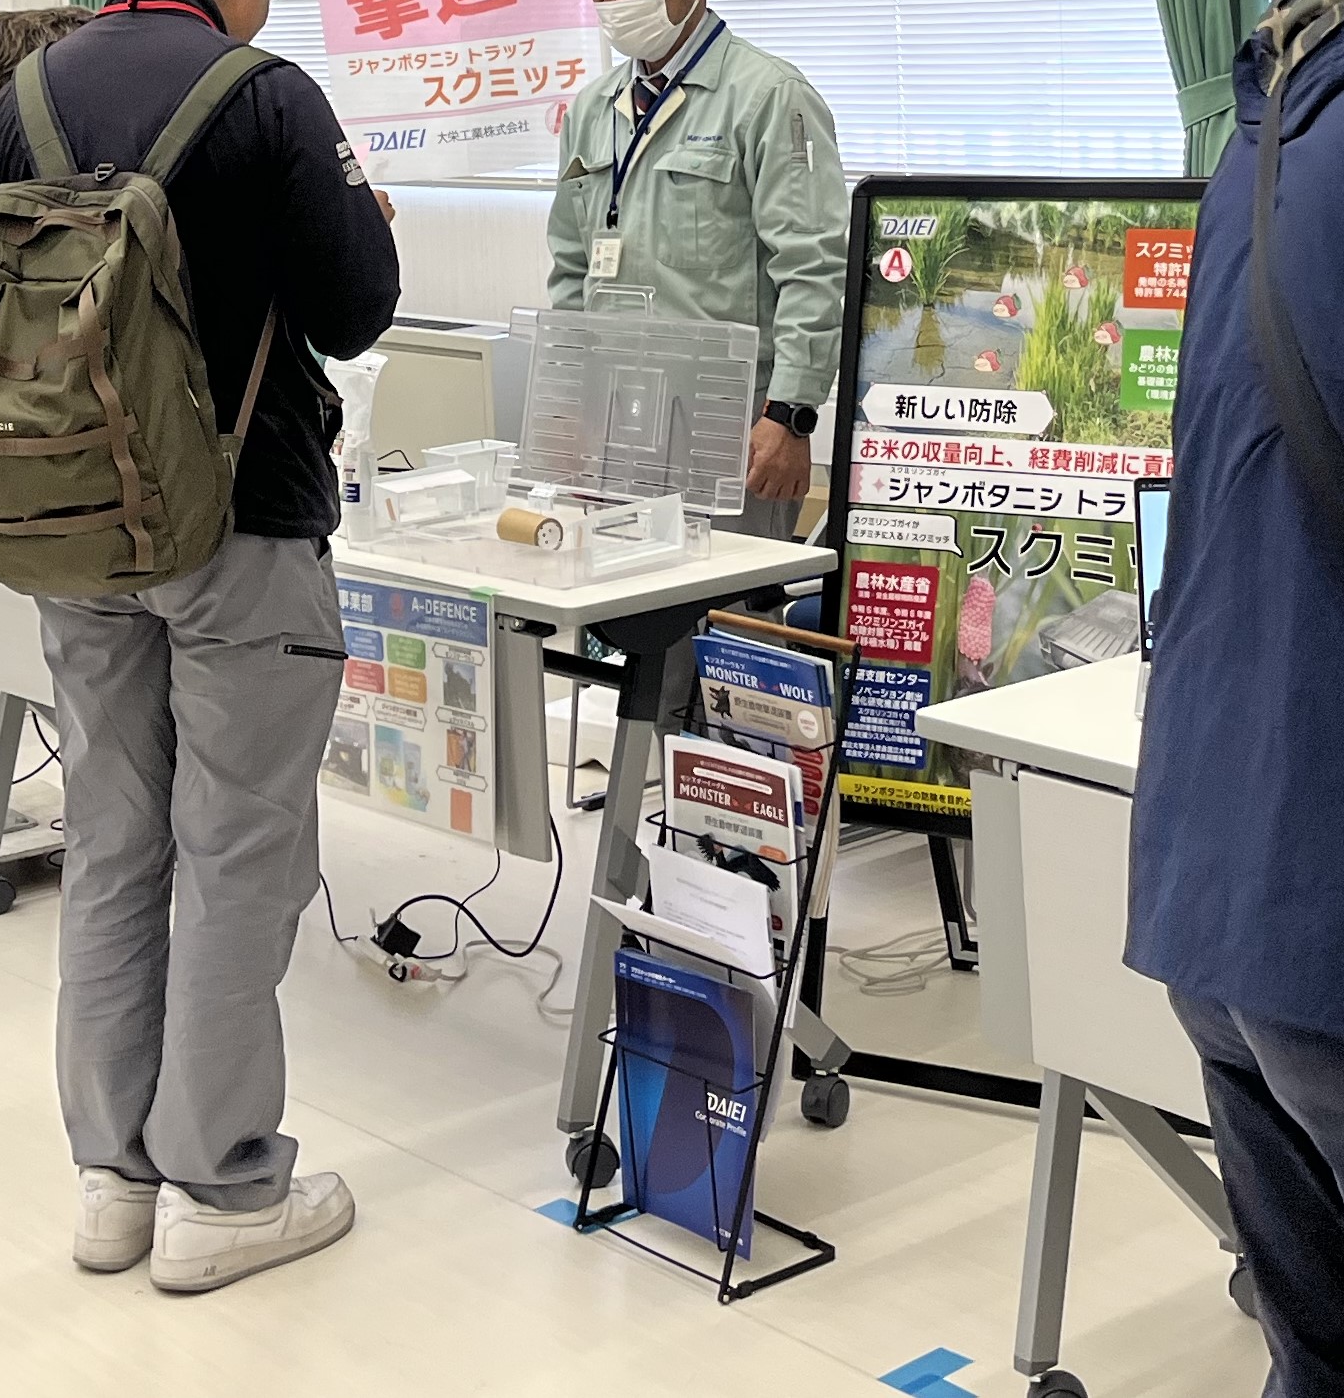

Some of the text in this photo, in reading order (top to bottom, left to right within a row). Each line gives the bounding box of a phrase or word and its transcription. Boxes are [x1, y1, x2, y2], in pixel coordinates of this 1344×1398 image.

[347, 38, 535, 76] ジャンボタニシ トラップ
[423, 58, 586, 107] スクミッチ
[363, 128, 426, 152] DAIEI
[437, 120, 530, 144] 大栄工業株式会社
[881, 218, 936, 236] DAIEI
[885, 249, 906, 278] A
[895, 395, 1018, 425] 新しい防除
[888, 476, 1062, 513] ジャンボタニシ
[967, 525, 1137, 585] スクミ
[856, 572, 931, 595] 農林水産省
[411, 596, 477, 623] A-DEFENCE
[855, 615, 925, 630] スクミリンゴガイ
[705, 664, 814, 702] MONSTER WOLF
[679, 782, 785, 822] MONSTER EAGLE
[706, 1091, 747, 1123] DAIEI
